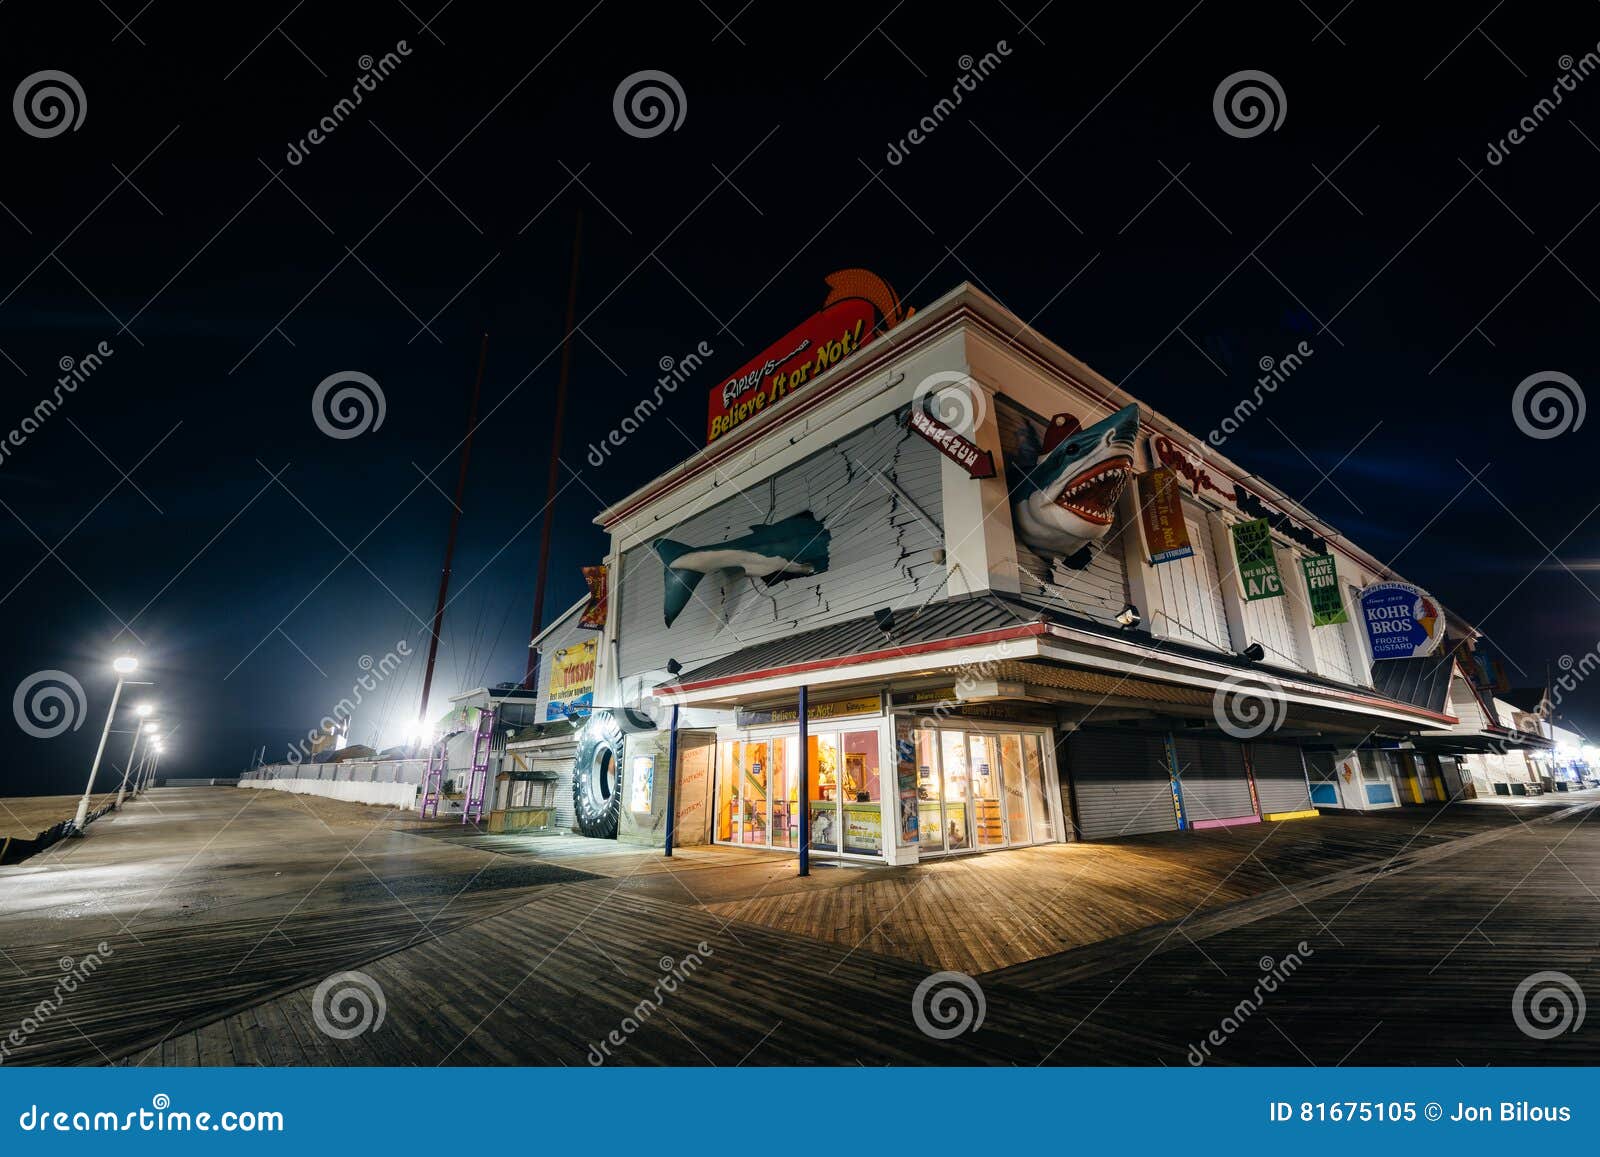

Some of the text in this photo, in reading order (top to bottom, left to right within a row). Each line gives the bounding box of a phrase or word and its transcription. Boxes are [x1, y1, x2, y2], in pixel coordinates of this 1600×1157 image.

[709, 320, 862, 441] Believe It or Not!
[912, 412, 979, 467] ENTRANCE
[1243, 569, 1255, 578] WE
[1308, 564, 1333, 577] HAVE
[1247, 575, 1280, 597] A/C
[1310, 574, 1335, 589] FUN
[1366, 604, 1412, 621] KOHR
[1370, 618, 1413, 634] BROS
[1374, 642, 1414, 652] CUSTARD
[1375, 636, 1409, 645] FROZEN
[771, 709, 797, 722] Believe
[816, 703, 834, 719] Not!
